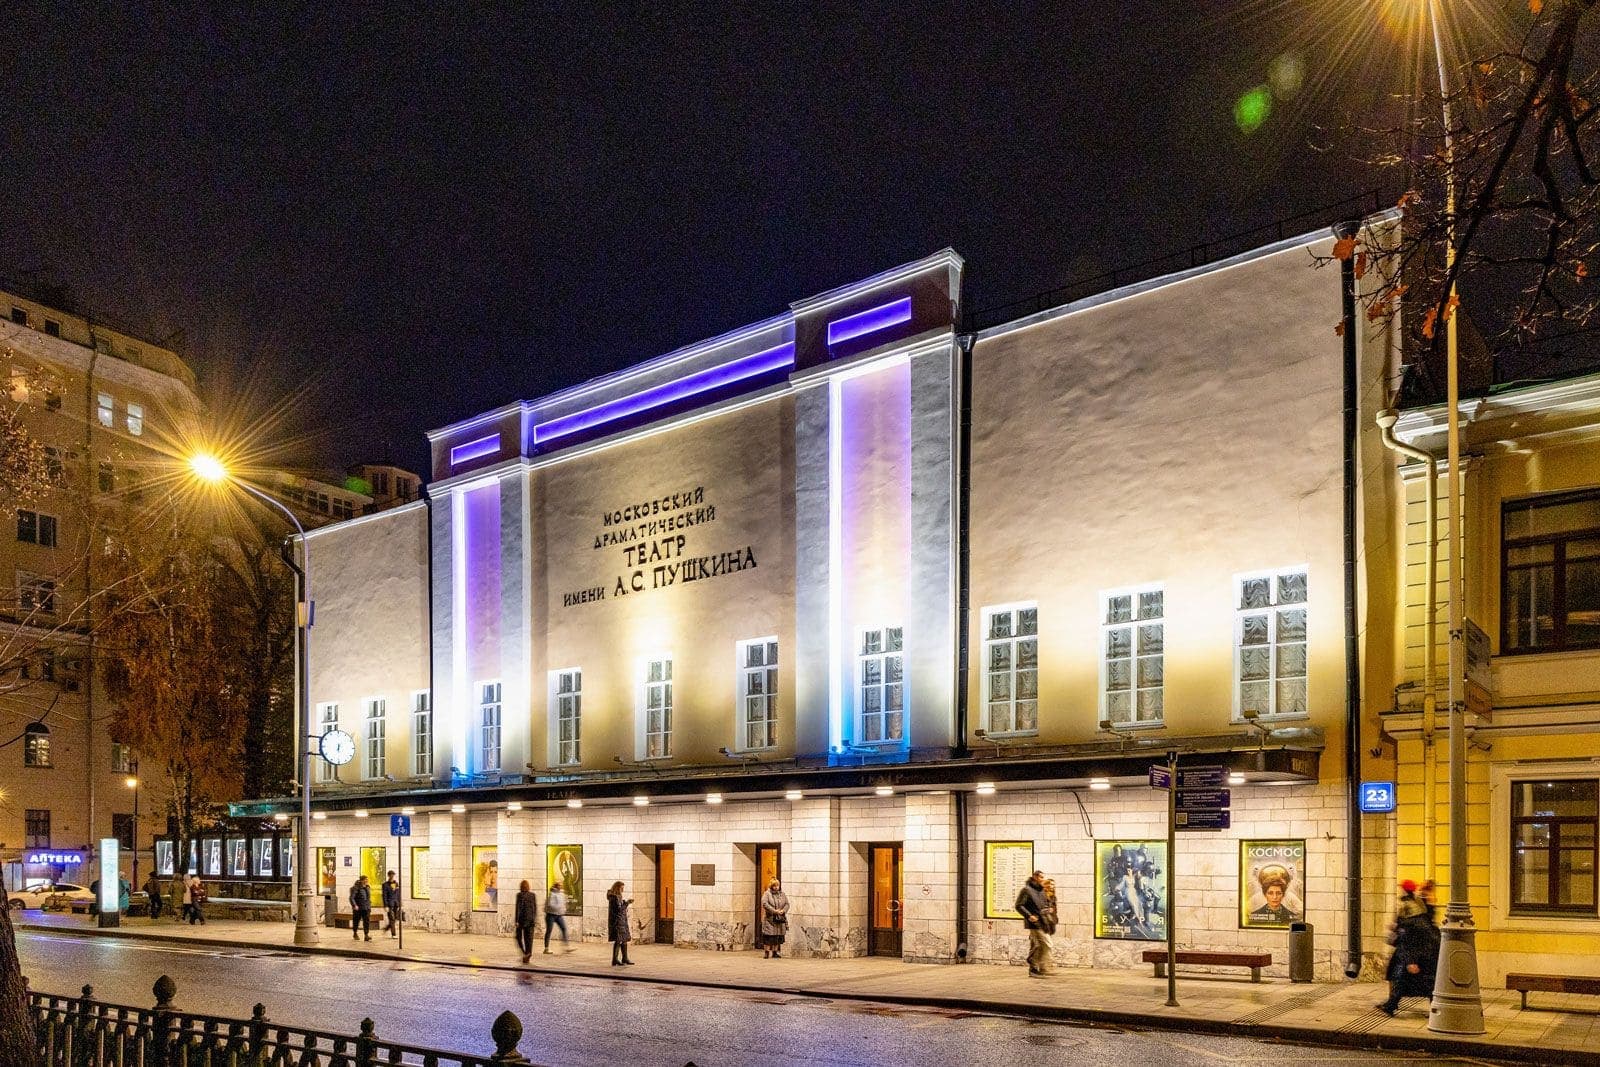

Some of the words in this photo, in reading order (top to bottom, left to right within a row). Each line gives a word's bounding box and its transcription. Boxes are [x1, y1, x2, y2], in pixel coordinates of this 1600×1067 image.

[603, 487, 704, 526] МОСКОВСКИЙ
[594, 505, 715, 549] ДРАМАТИЧЕСКИЙ
[623, 535, 686, 567] ТЕАТР
[563, 587, 605, 607] ИМЕНИ
[653, 546, 757, 588] ПУШКИНА
[1366, 789, 1388, 802] 23
[29, 853, 81, 864] АПТЕКА
[1248, 847, 1302, 857] КОСМОС
